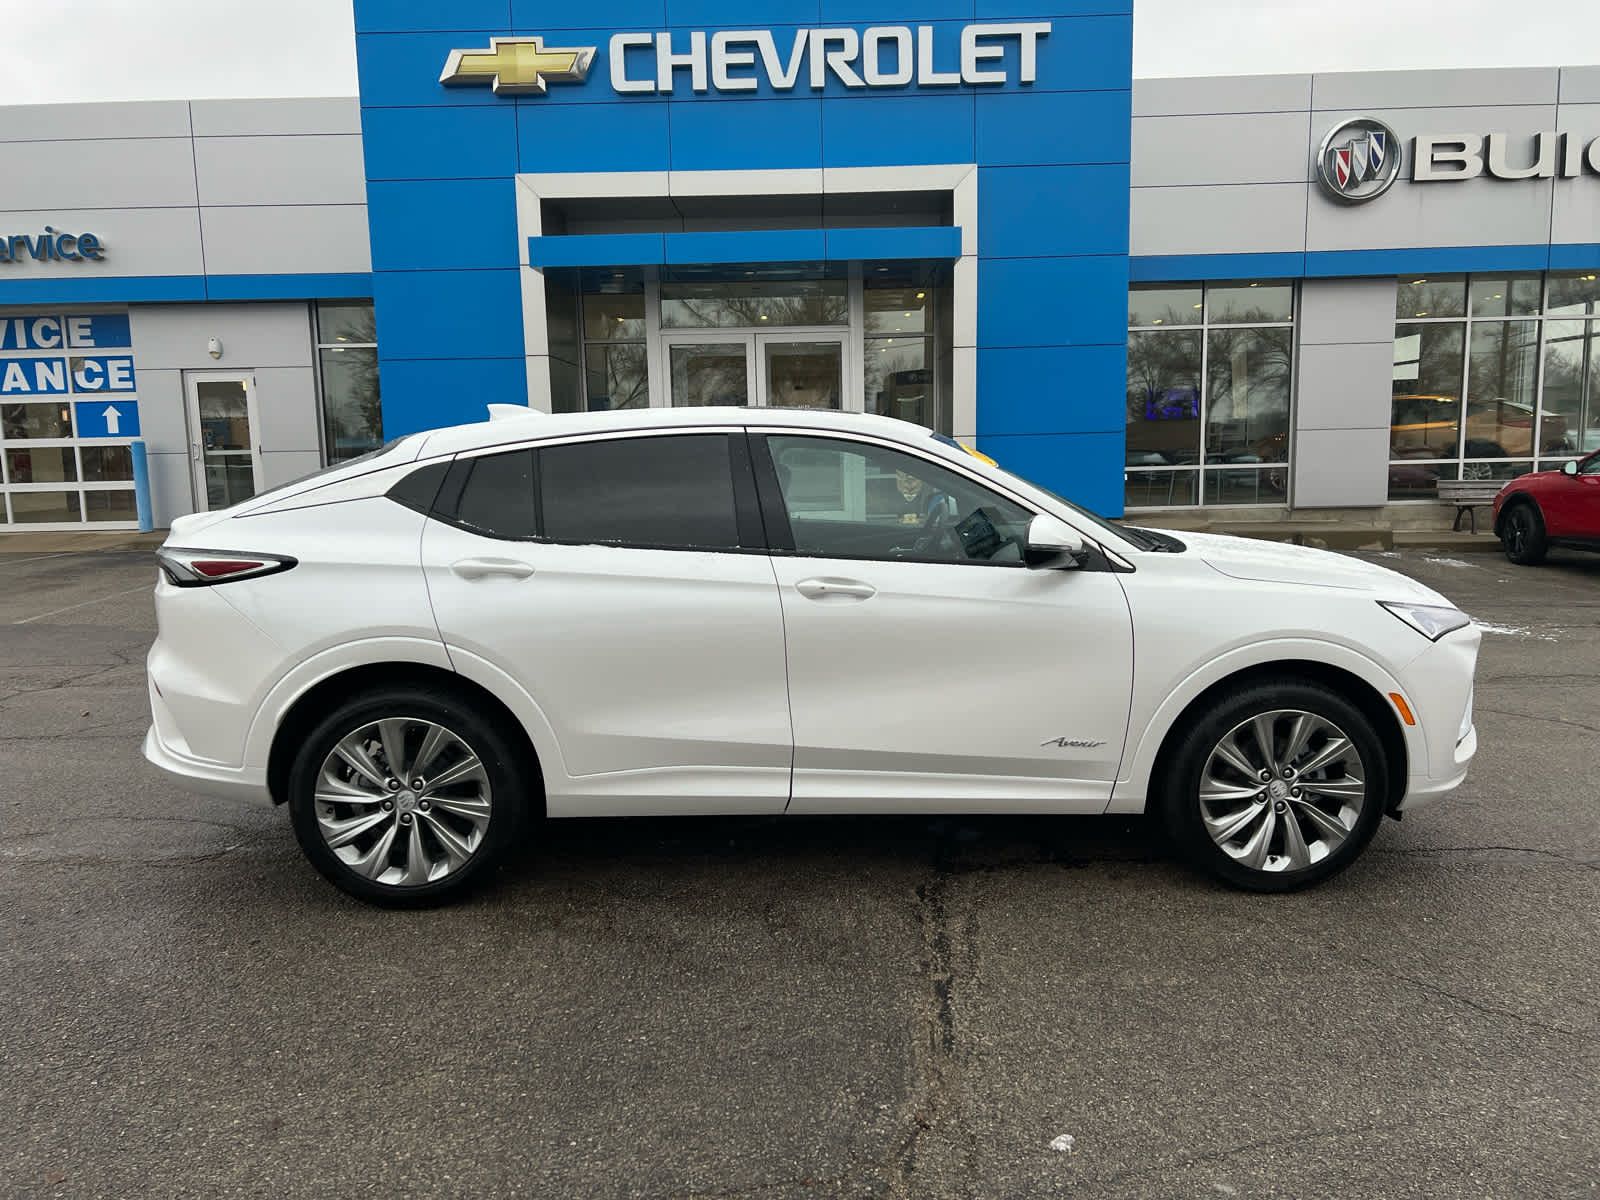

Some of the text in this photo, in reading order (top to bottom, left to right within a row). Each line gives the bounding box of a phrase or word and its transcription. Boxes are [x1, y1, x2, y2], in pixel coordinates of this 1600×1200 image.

[609, 22, 1051, 94] CHEVROLET
[1412, 132, 1600, 181] BUI
[0, 317, 95, 349] ICE
[2, 359, 134, 392] ANCE
[1040, 736, 1107, 748] Avenir
